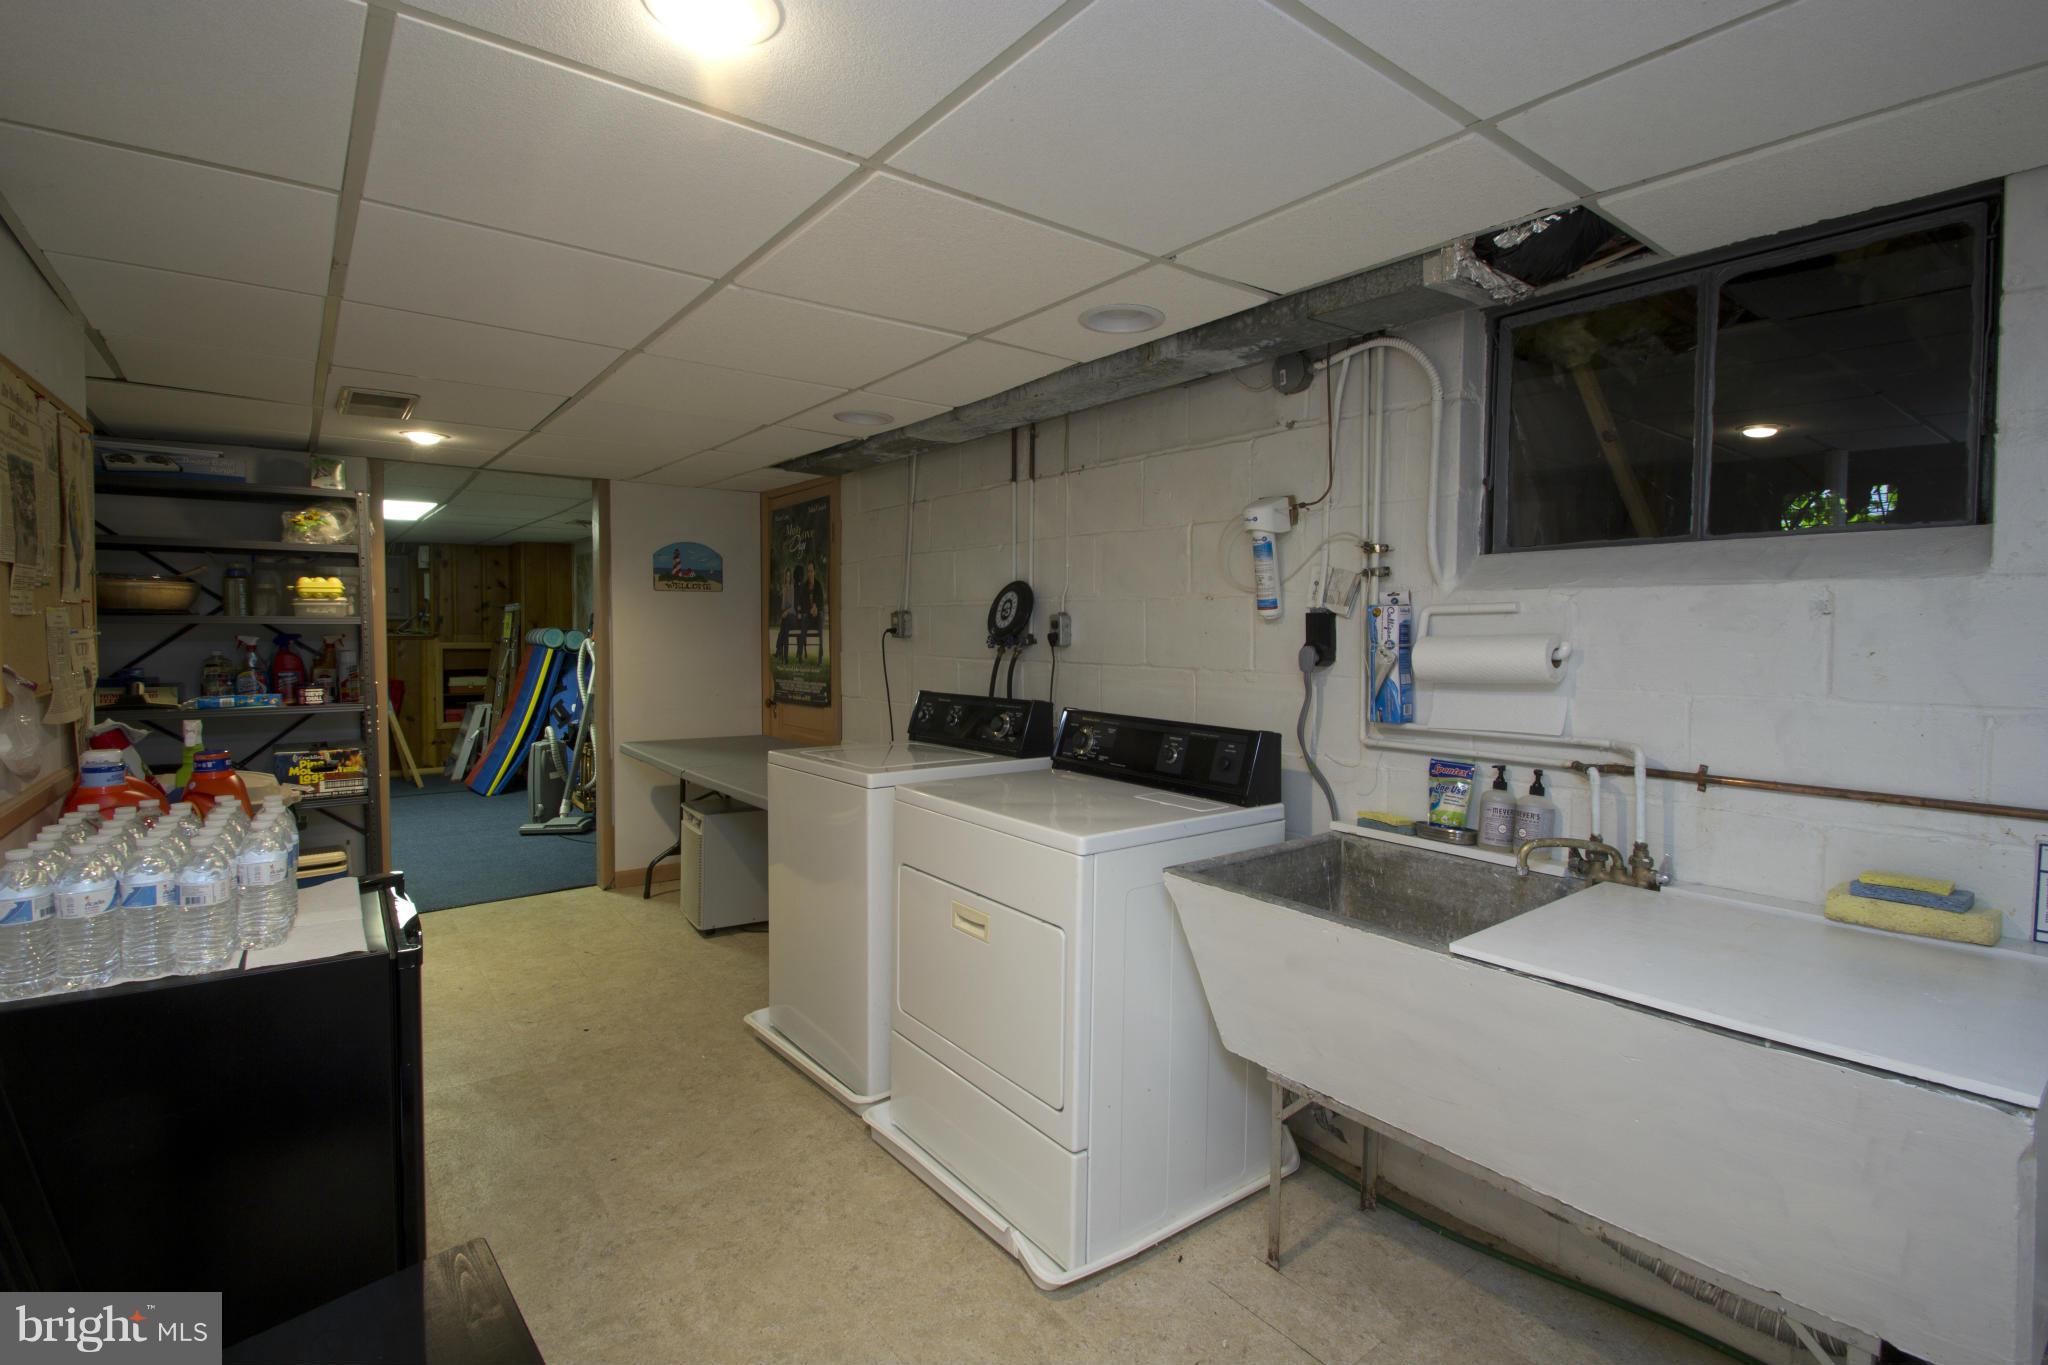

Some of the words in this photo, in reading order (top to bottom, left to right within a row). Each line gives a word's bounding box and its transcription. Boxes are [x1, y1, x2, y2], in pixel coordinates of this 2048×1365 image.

[665, 581, 712, 591] WELCOME
[1434, 764, 1469, 777] Spontex
[1435, 783, 1450, 793] One
[1451, 785, 1467, 796] Use
